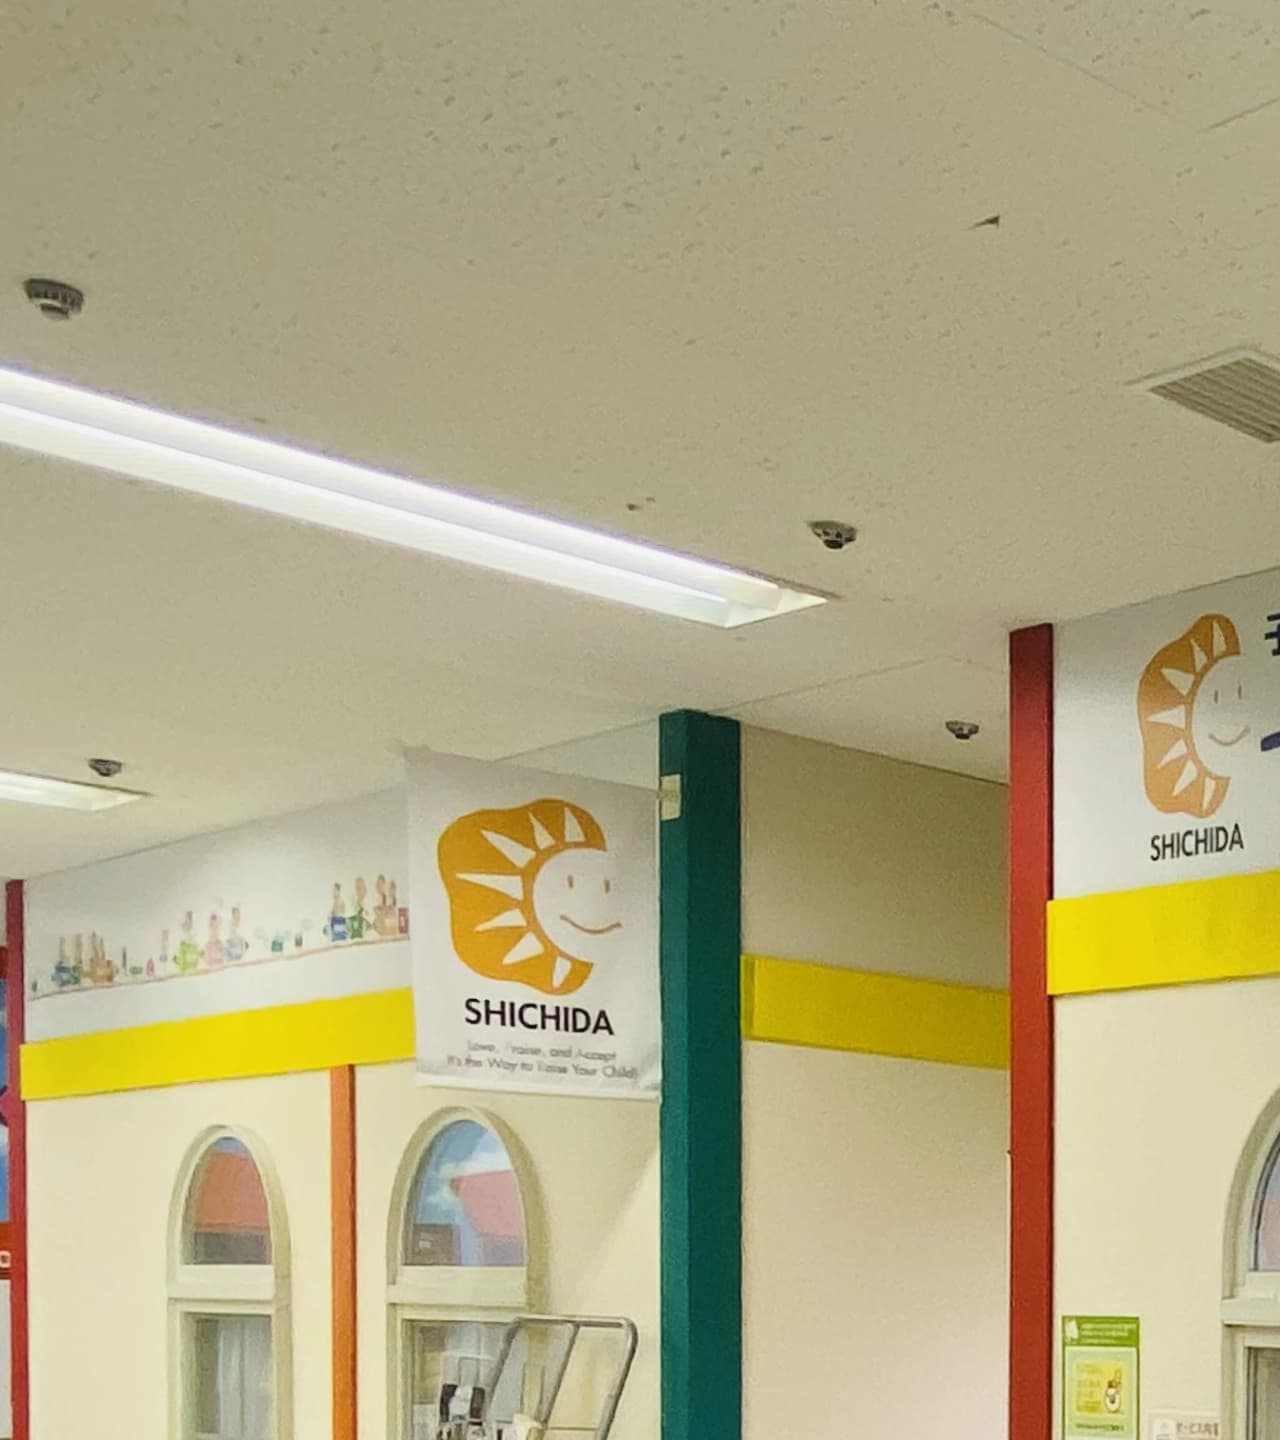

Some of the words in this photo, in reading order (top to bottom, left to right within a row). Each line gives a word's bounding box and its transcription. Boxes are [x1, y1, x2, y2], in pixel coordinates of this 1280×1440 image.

[1150, 822, 1244, 861] SHICHIDA
[464, 997, 615, 1036] SHICHIDA
[487, 1057, 518, 1072] Way
[550, 1045, 572, 1058] and
